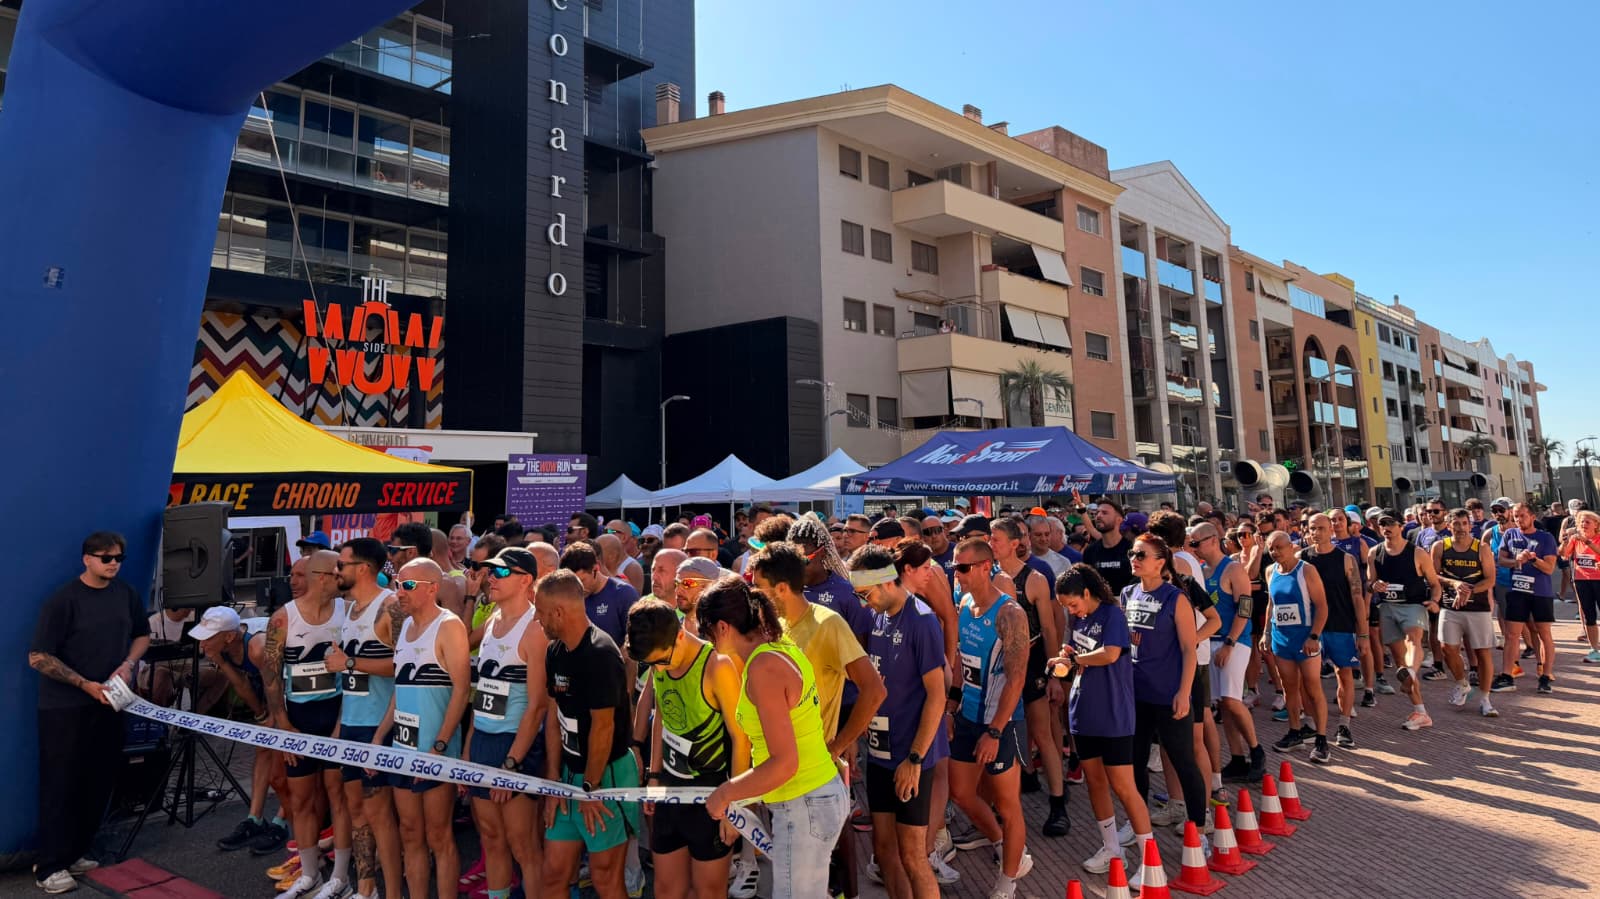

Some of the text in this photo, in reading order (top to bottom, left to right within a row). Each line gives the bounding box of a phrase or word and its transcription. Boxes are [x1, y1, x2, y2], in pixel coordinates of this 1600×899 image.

[361, 276, 392, 307] THE
[363, 342, 386, 353] SIDE
[903, 481, 1019, 492] www.nonsolosport.it
[189, 482, 459, 510] RACE CHRONO SERVICE
[1385, 591, 1398, 599] 20
[1277, 612, 1297, 622] 804
[309, 676, 317, 689] 1
[348, 676, 356, 689] 9
[482, 693, 495, 711] 13
[200, 721, 225, 734] OPES
[224, 727, 251, 740] OPES
[399, 725, 410, 742] 10
[251, 732, 279, 746] OPES
[280, 737, 308, 752] OPES
[310, 742, 338, 758] OPES
[341, 747, 370, 763] OPES
[374, 752, 404, 770] OPES
[669, 749, 676, 767] 5
[410, 758, 443, 777] OPES
[448, 767, 485, 784] OPES
[491, 776, 529, 791] OPES
